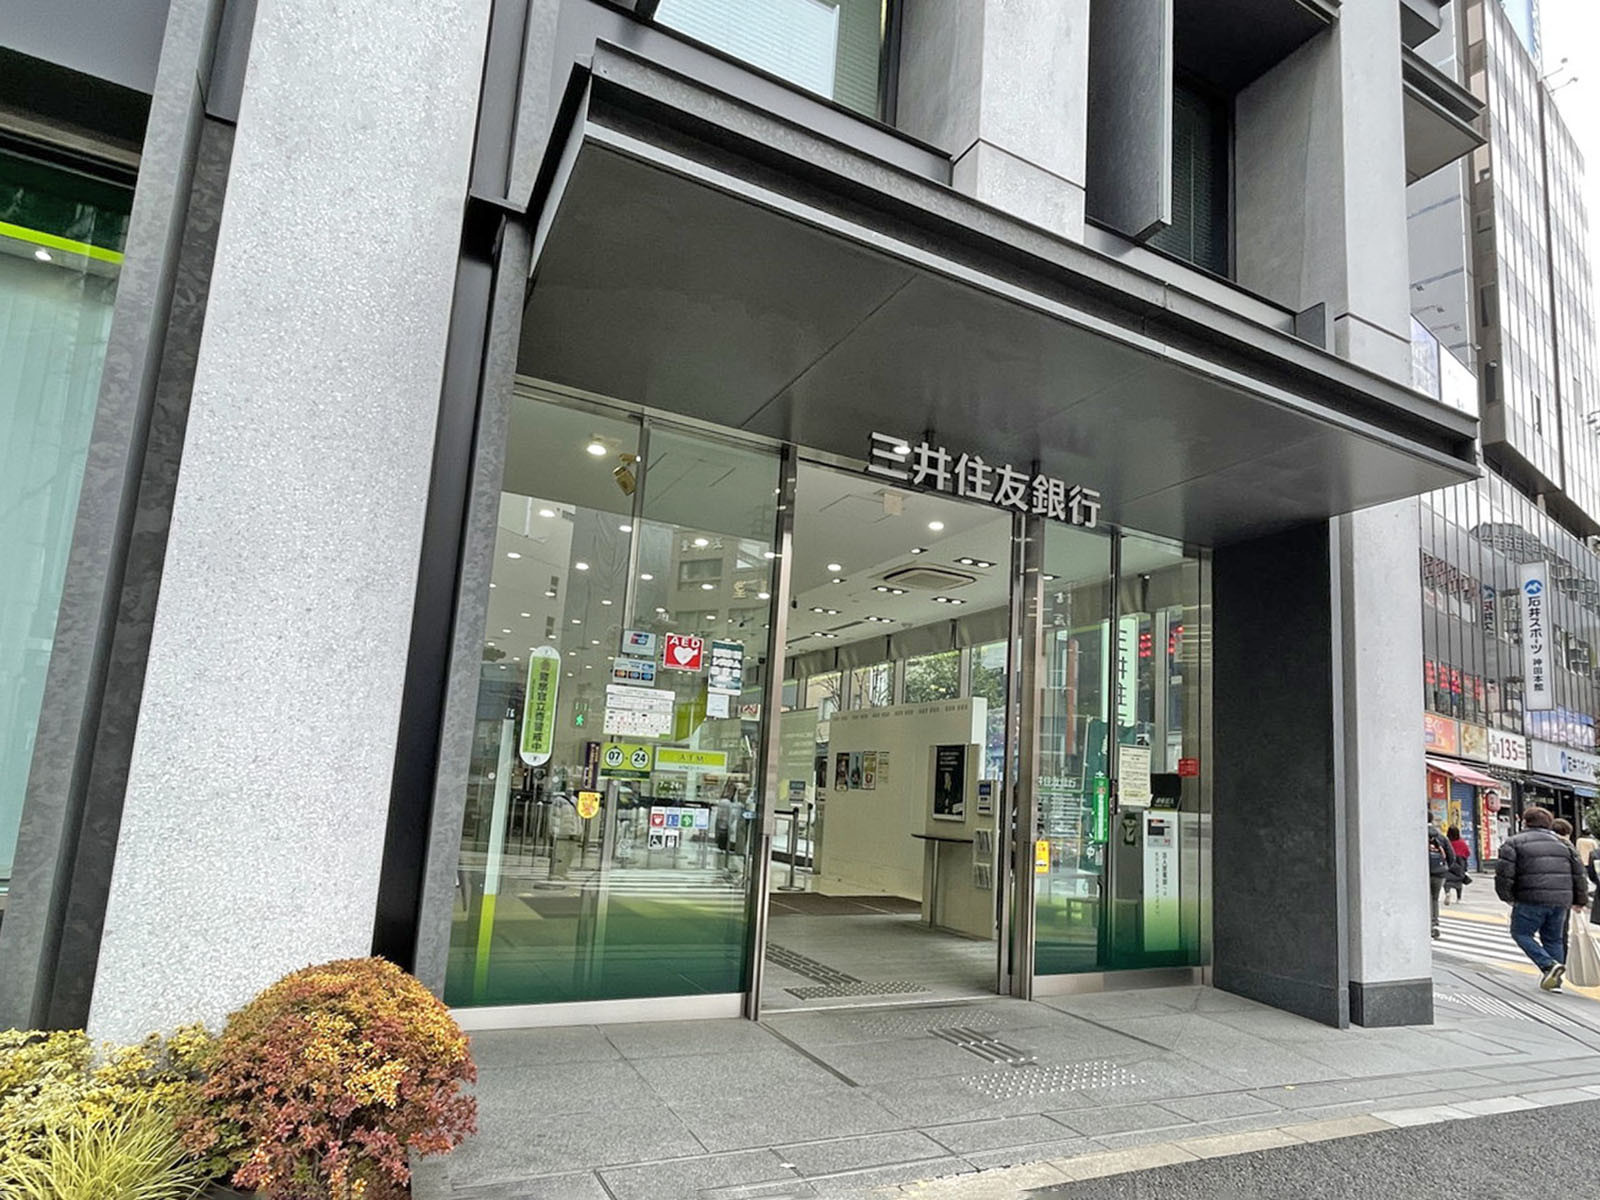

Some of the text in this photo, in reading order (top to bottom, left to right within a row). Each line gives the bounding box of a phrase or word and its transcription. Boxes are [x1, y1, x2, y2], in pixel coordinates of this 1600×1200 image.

[868, 432, 1101, 529] 三井住友銀行
[1528, 596, 1543, 654] 石井スポーツ
[669, 636, 700, 648] AED
[608, 751, 646, 762] 07 24
[1500, 737, 1518, 761] 135
